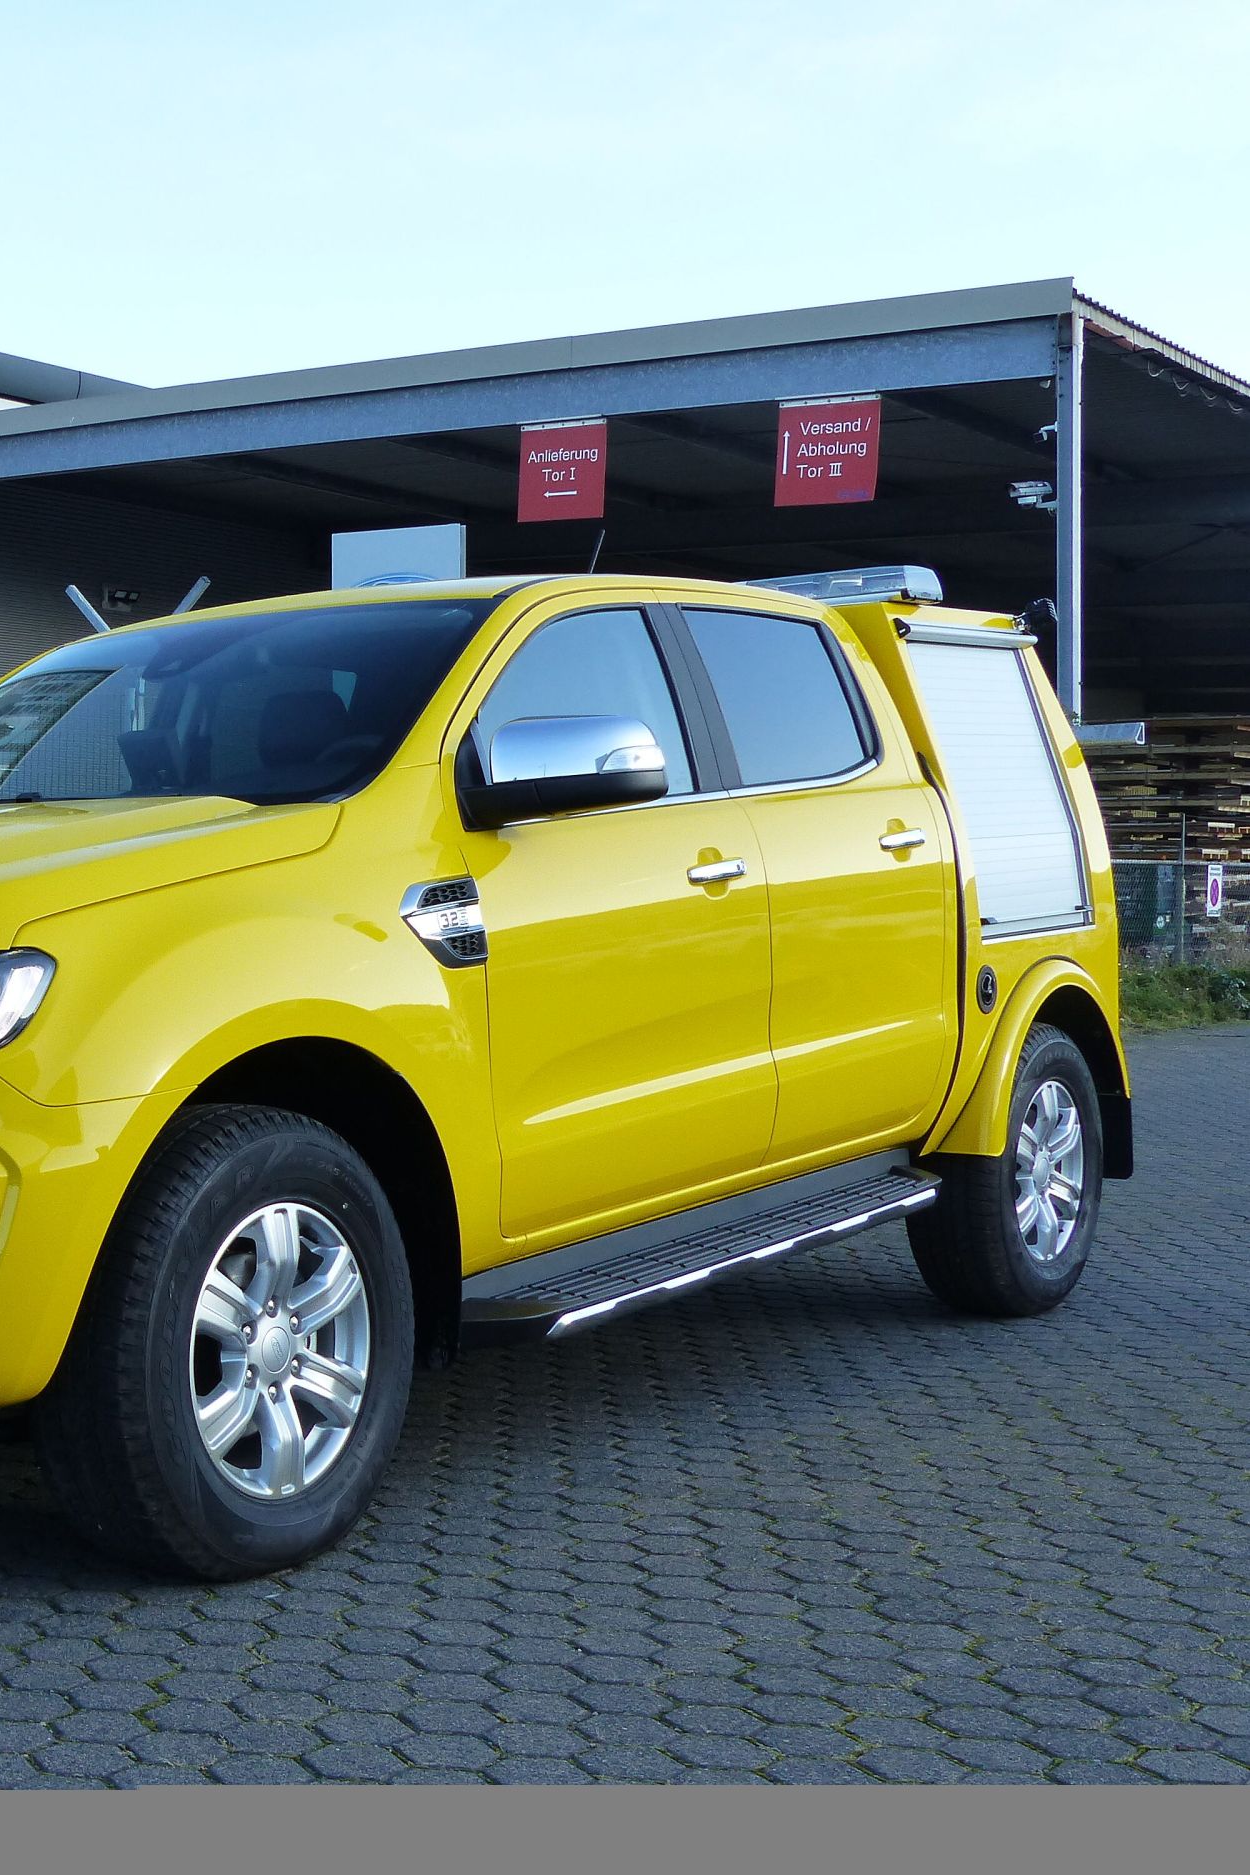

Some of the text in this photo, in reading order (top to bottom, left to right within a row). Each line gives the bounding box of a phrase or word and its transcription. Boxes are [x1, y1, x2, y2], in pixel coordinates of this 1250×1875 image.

[800, 418, 862, 436] Versand
[527, 446, 599, 465] Anlieferung
[796, 440, 867, 459] Abholung
[542, 468, 567, 483] Tor
[796, 464, 824, 479] Tor
